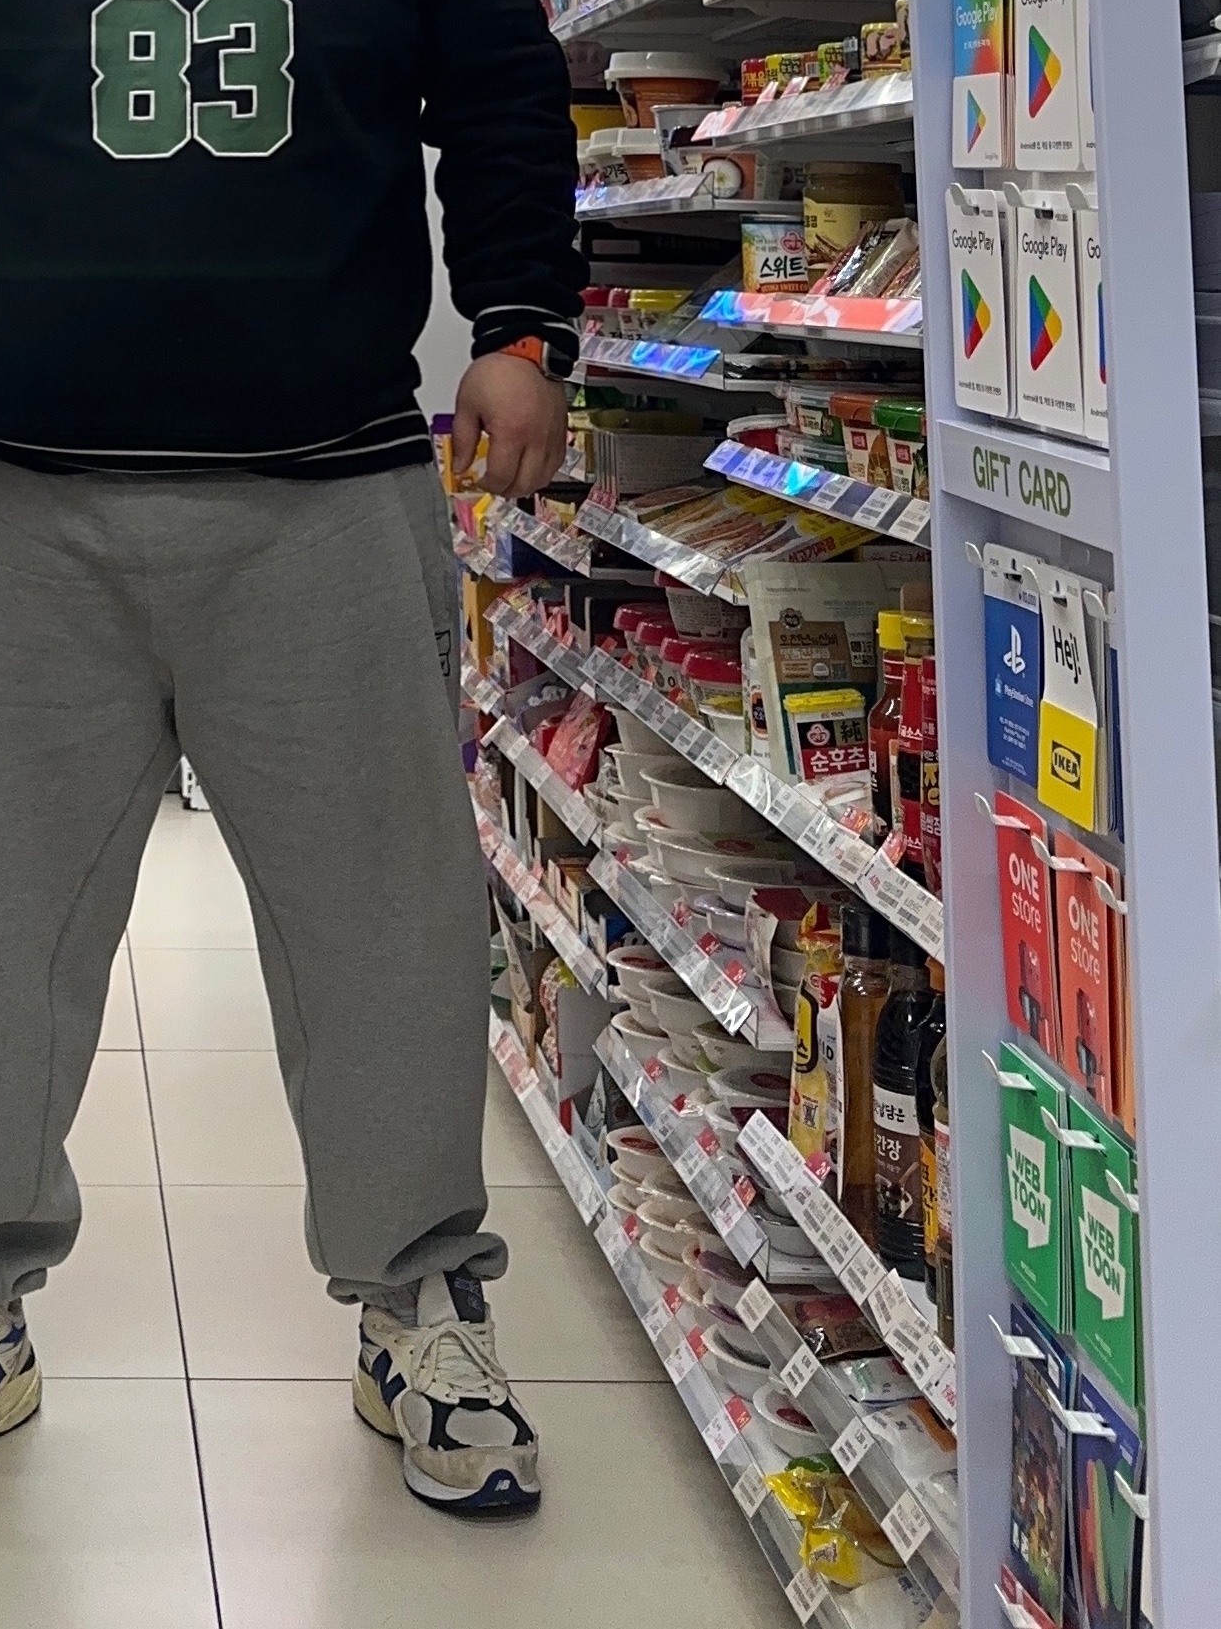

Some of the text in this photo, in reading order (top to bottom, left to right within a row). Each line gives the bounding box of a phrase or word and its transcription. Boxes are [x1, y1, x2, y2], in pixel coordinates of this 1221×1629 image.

[955, 0, 999, 31] Google Play
[951, 228, 996, 256] Google Play
[1021, 232, 1068, 263] Google Play
[972, 444, 1072, 518] GIFT CARD
[1052, 625, 1082, 685] Hej!
[809, 747, 867, 773] 순후추
[1053, 750, 1079, 777] IKEA
[1008, 852, 1041, 903] ONE
[1011, 892, 1042, 934] store
[1067, 895, 1100, 952] ONE
[1070, 937, 1101, 985] store
[1013, 1147, 1042, 1195] WEB
[1011, 1170, 1047, 1226] TOON
[1086, 1211, 1116, 1262] WEB
[1084, 1234, 1122, 1297] TOON
